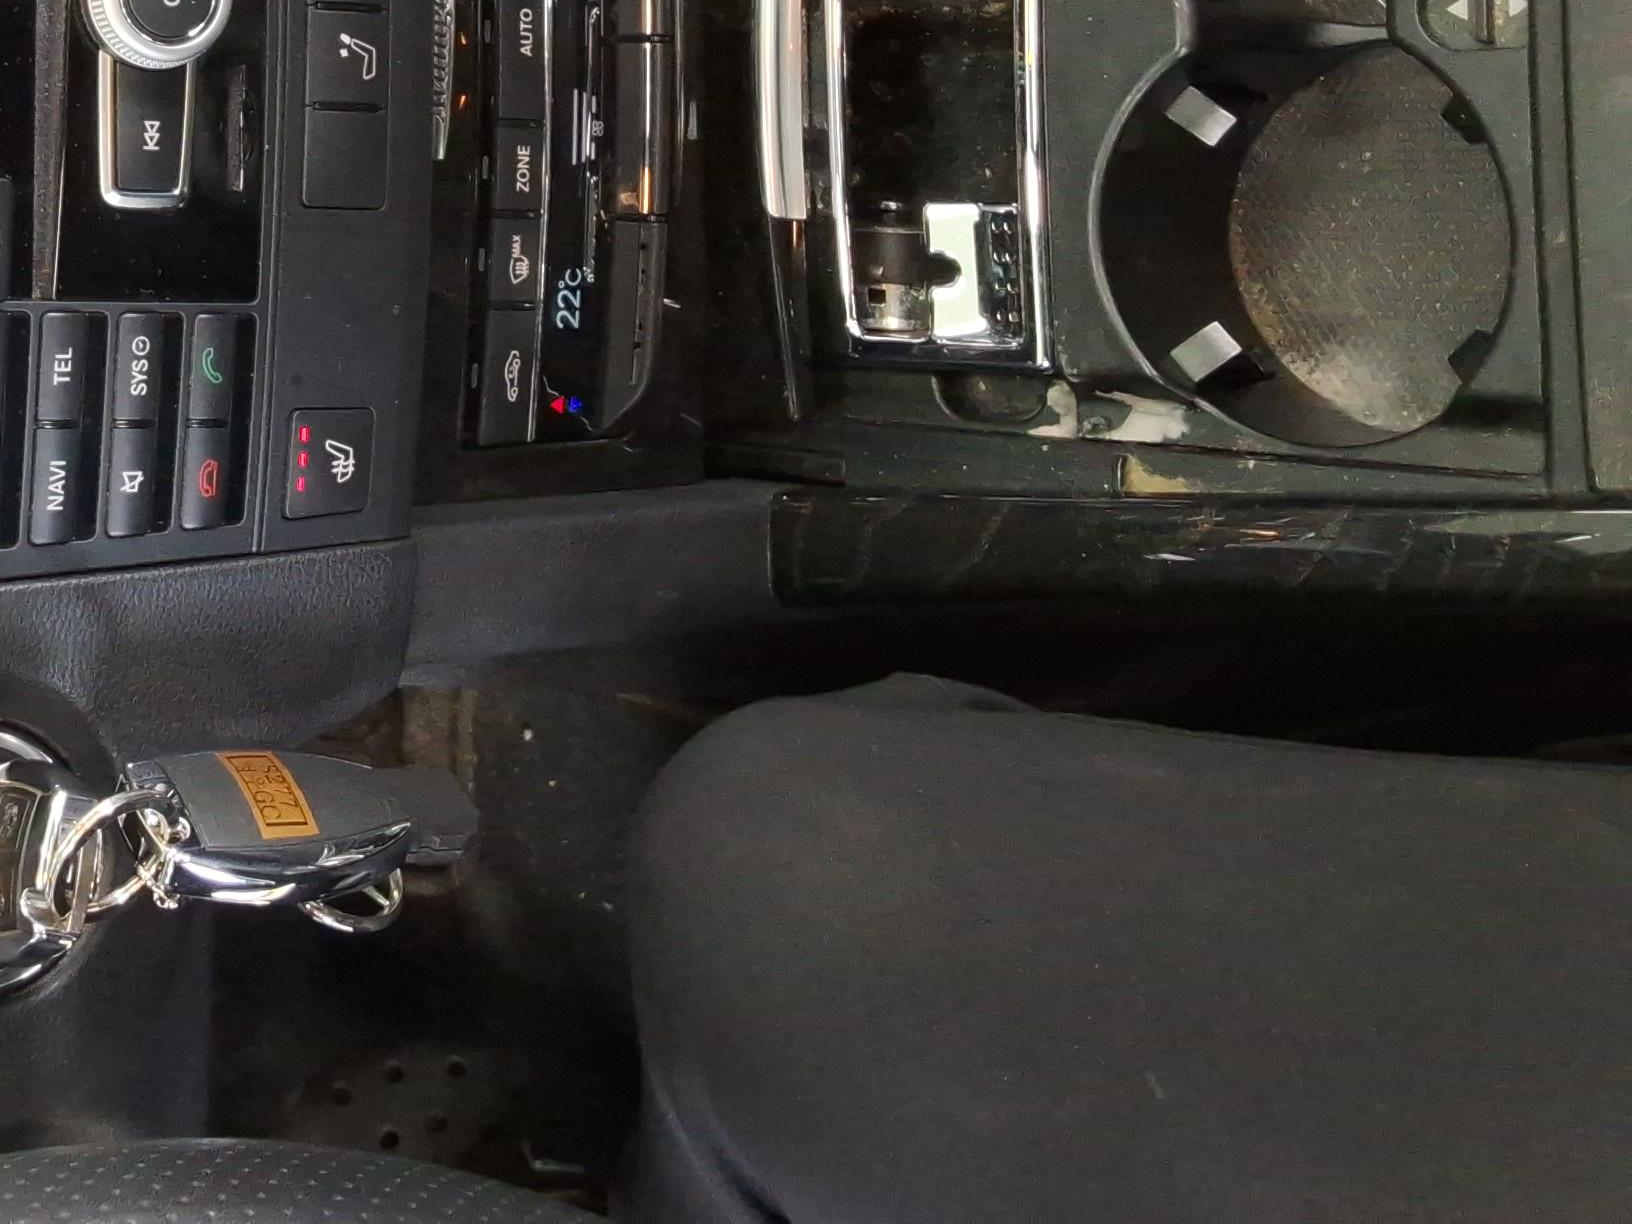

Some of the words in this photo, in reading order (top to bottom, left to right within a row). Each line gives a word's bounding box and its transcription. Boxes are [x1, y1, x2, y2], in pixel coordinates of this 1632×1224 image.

[518, 7, 534, 57] AUTO
[515, 144, 532, 193] ZONE
[511, 234, 522, 258] MAX
[53, 347, 72, 386] TEL
[130, 358, 149, 396] SYS
[47, 459, 67, 512] NAVI
